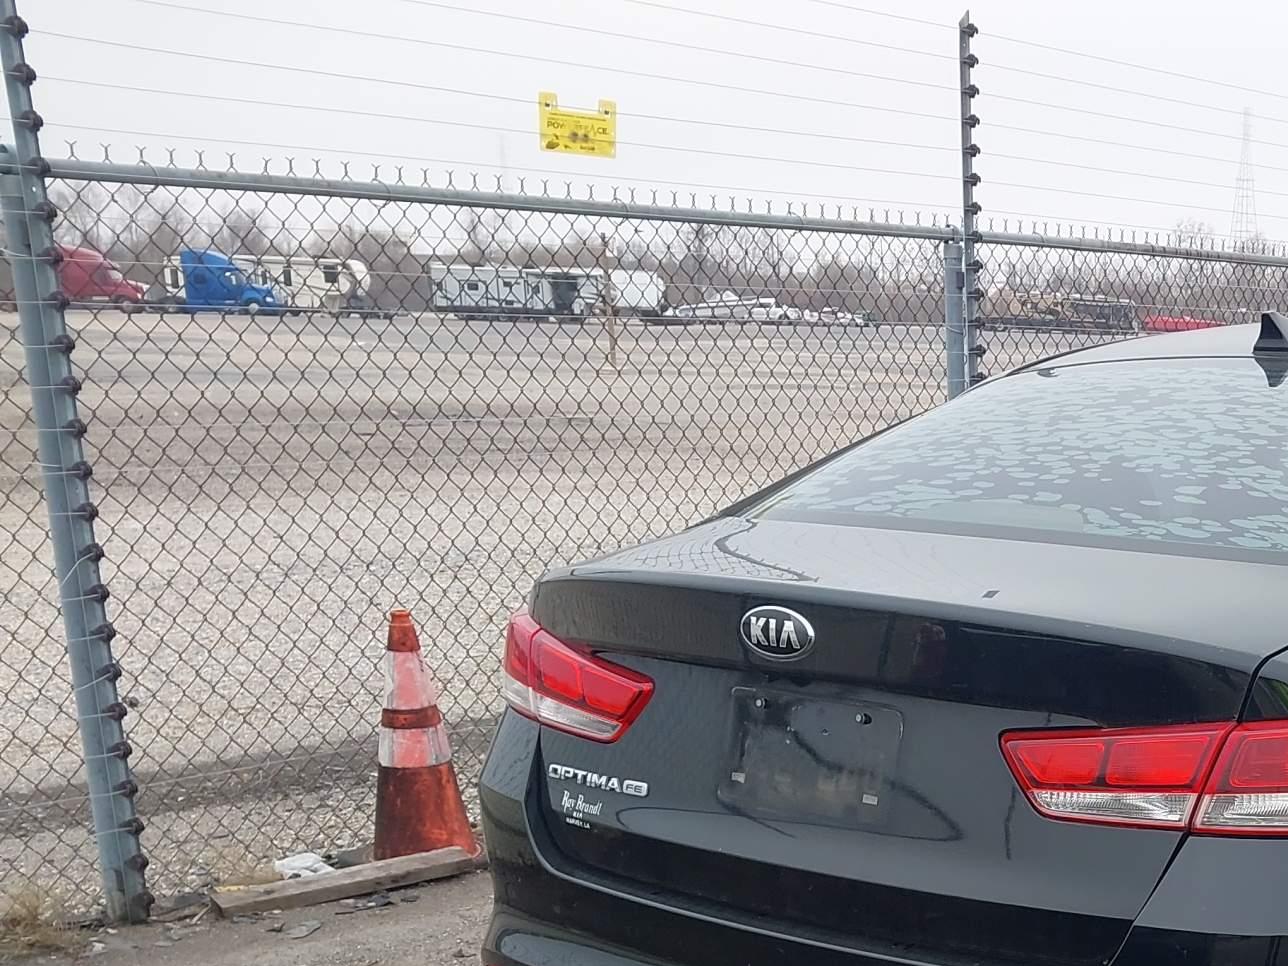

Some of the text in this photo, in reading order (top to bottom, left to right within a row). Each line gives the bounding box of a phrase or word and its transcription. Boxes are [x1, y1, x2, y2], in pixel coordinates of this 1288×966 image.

[749, 615, 801, 649] KIA
[548, 763, 623, 794] OPTIMA
[575, 794, 602, 816] Brandt
